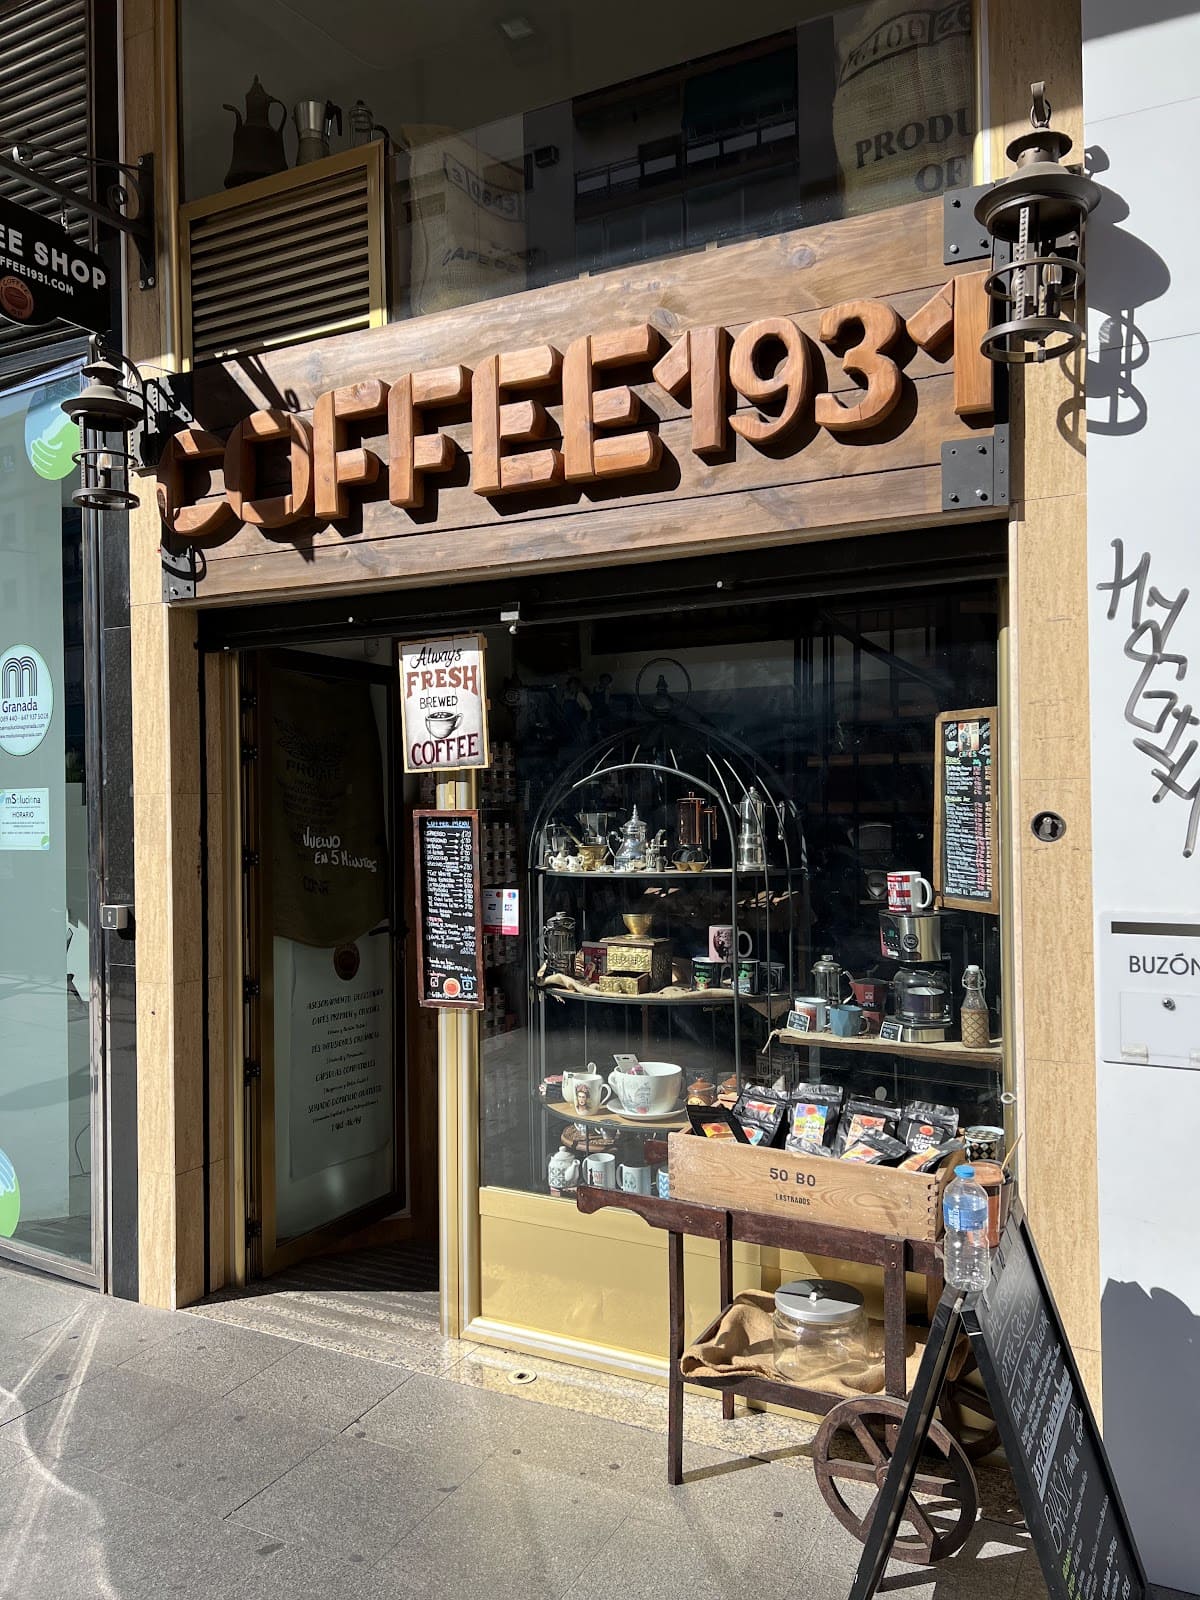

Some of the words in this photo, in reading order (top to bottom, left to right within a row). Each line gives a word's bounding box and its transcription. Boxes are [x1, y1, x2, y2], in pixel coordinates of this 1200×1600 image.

[34, 241, 106, 289] SHOP
[410, 646, 462, 668] Always
[407, 665, 478, 698] FRESH
[2, 698, 38, 713] Granada
[420, 696, 459, 709] BREWED
[411, 733, 479, 766] COFFEE
[314, 851, 329, 865] EN
[331, 850, 339, 865] 5
[770, 1167, 788, 1181] 50
[796, 1172, 816, 1187] BO
